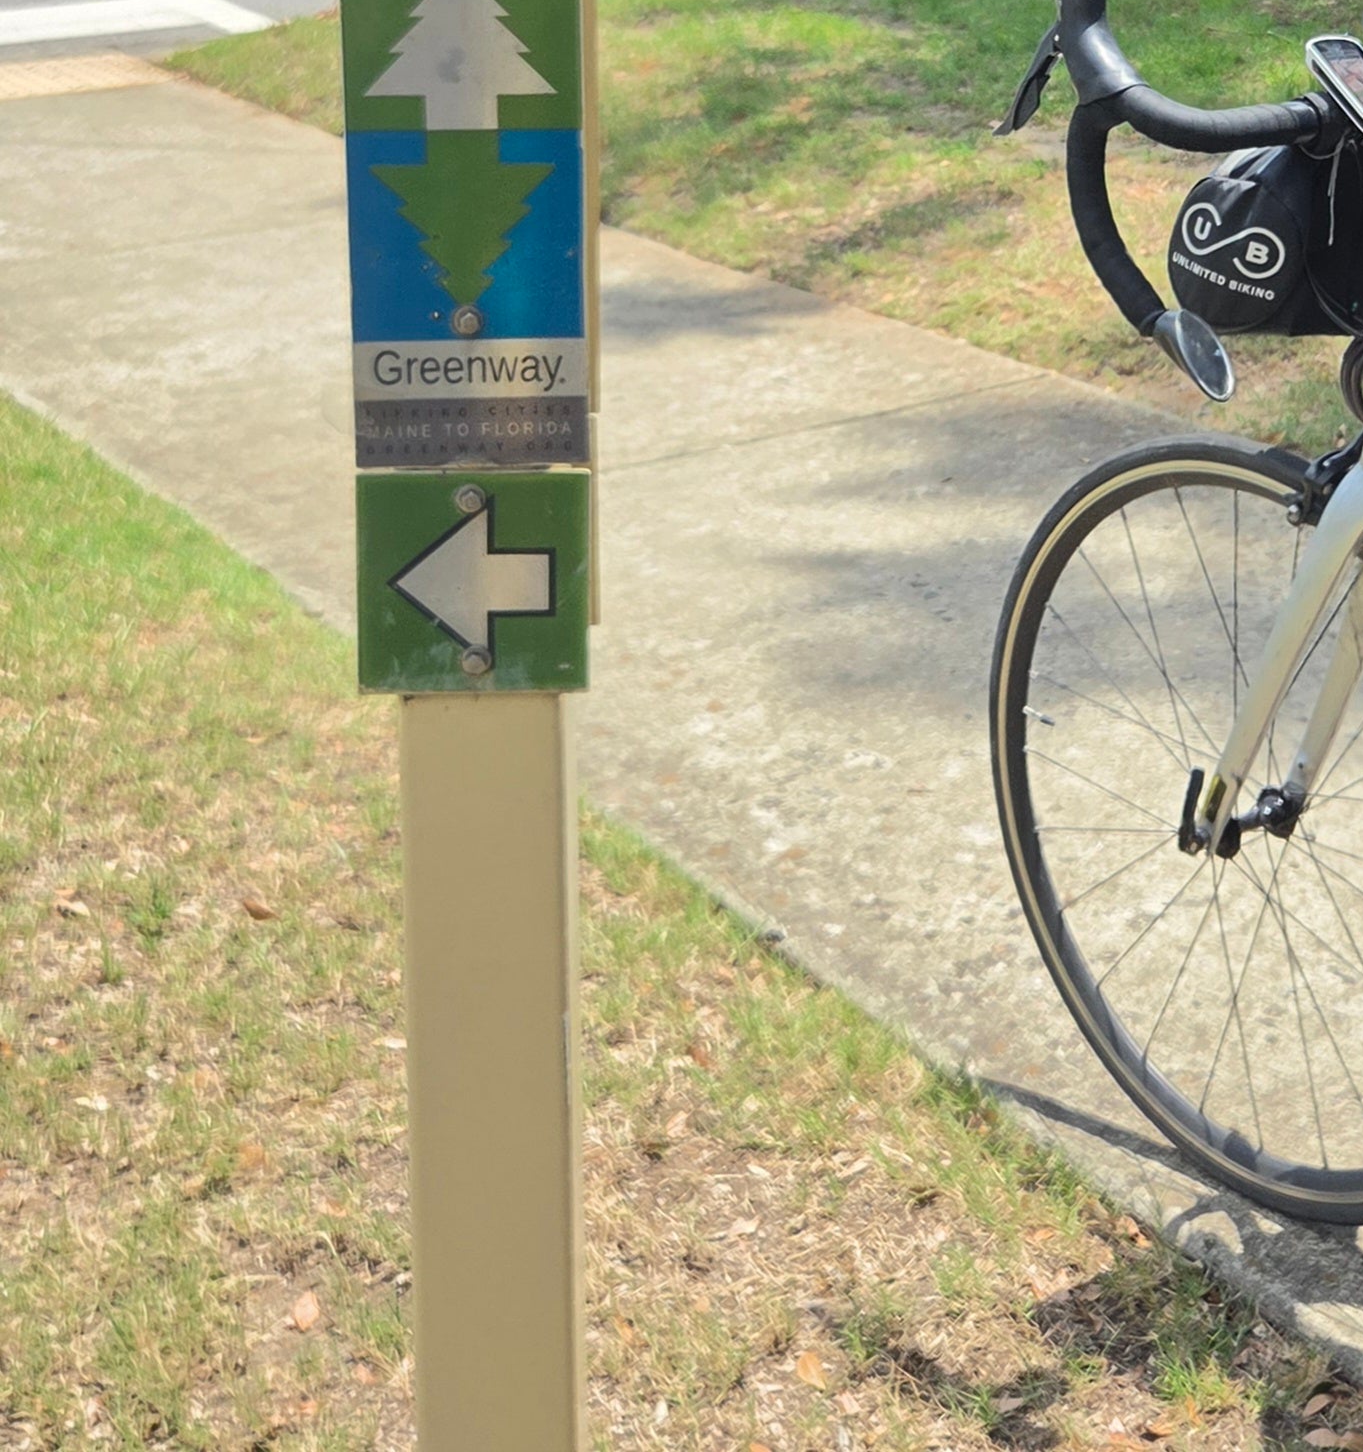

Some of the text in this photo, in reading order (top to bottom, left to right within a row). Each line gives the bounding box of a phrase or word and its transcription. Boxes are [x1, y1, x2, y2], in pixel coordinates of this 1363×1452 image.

[1171, 251, 1276, 301] UNLIMITED BIKING
[367, 420, 573, 440] MAINE TO FLORIDA
